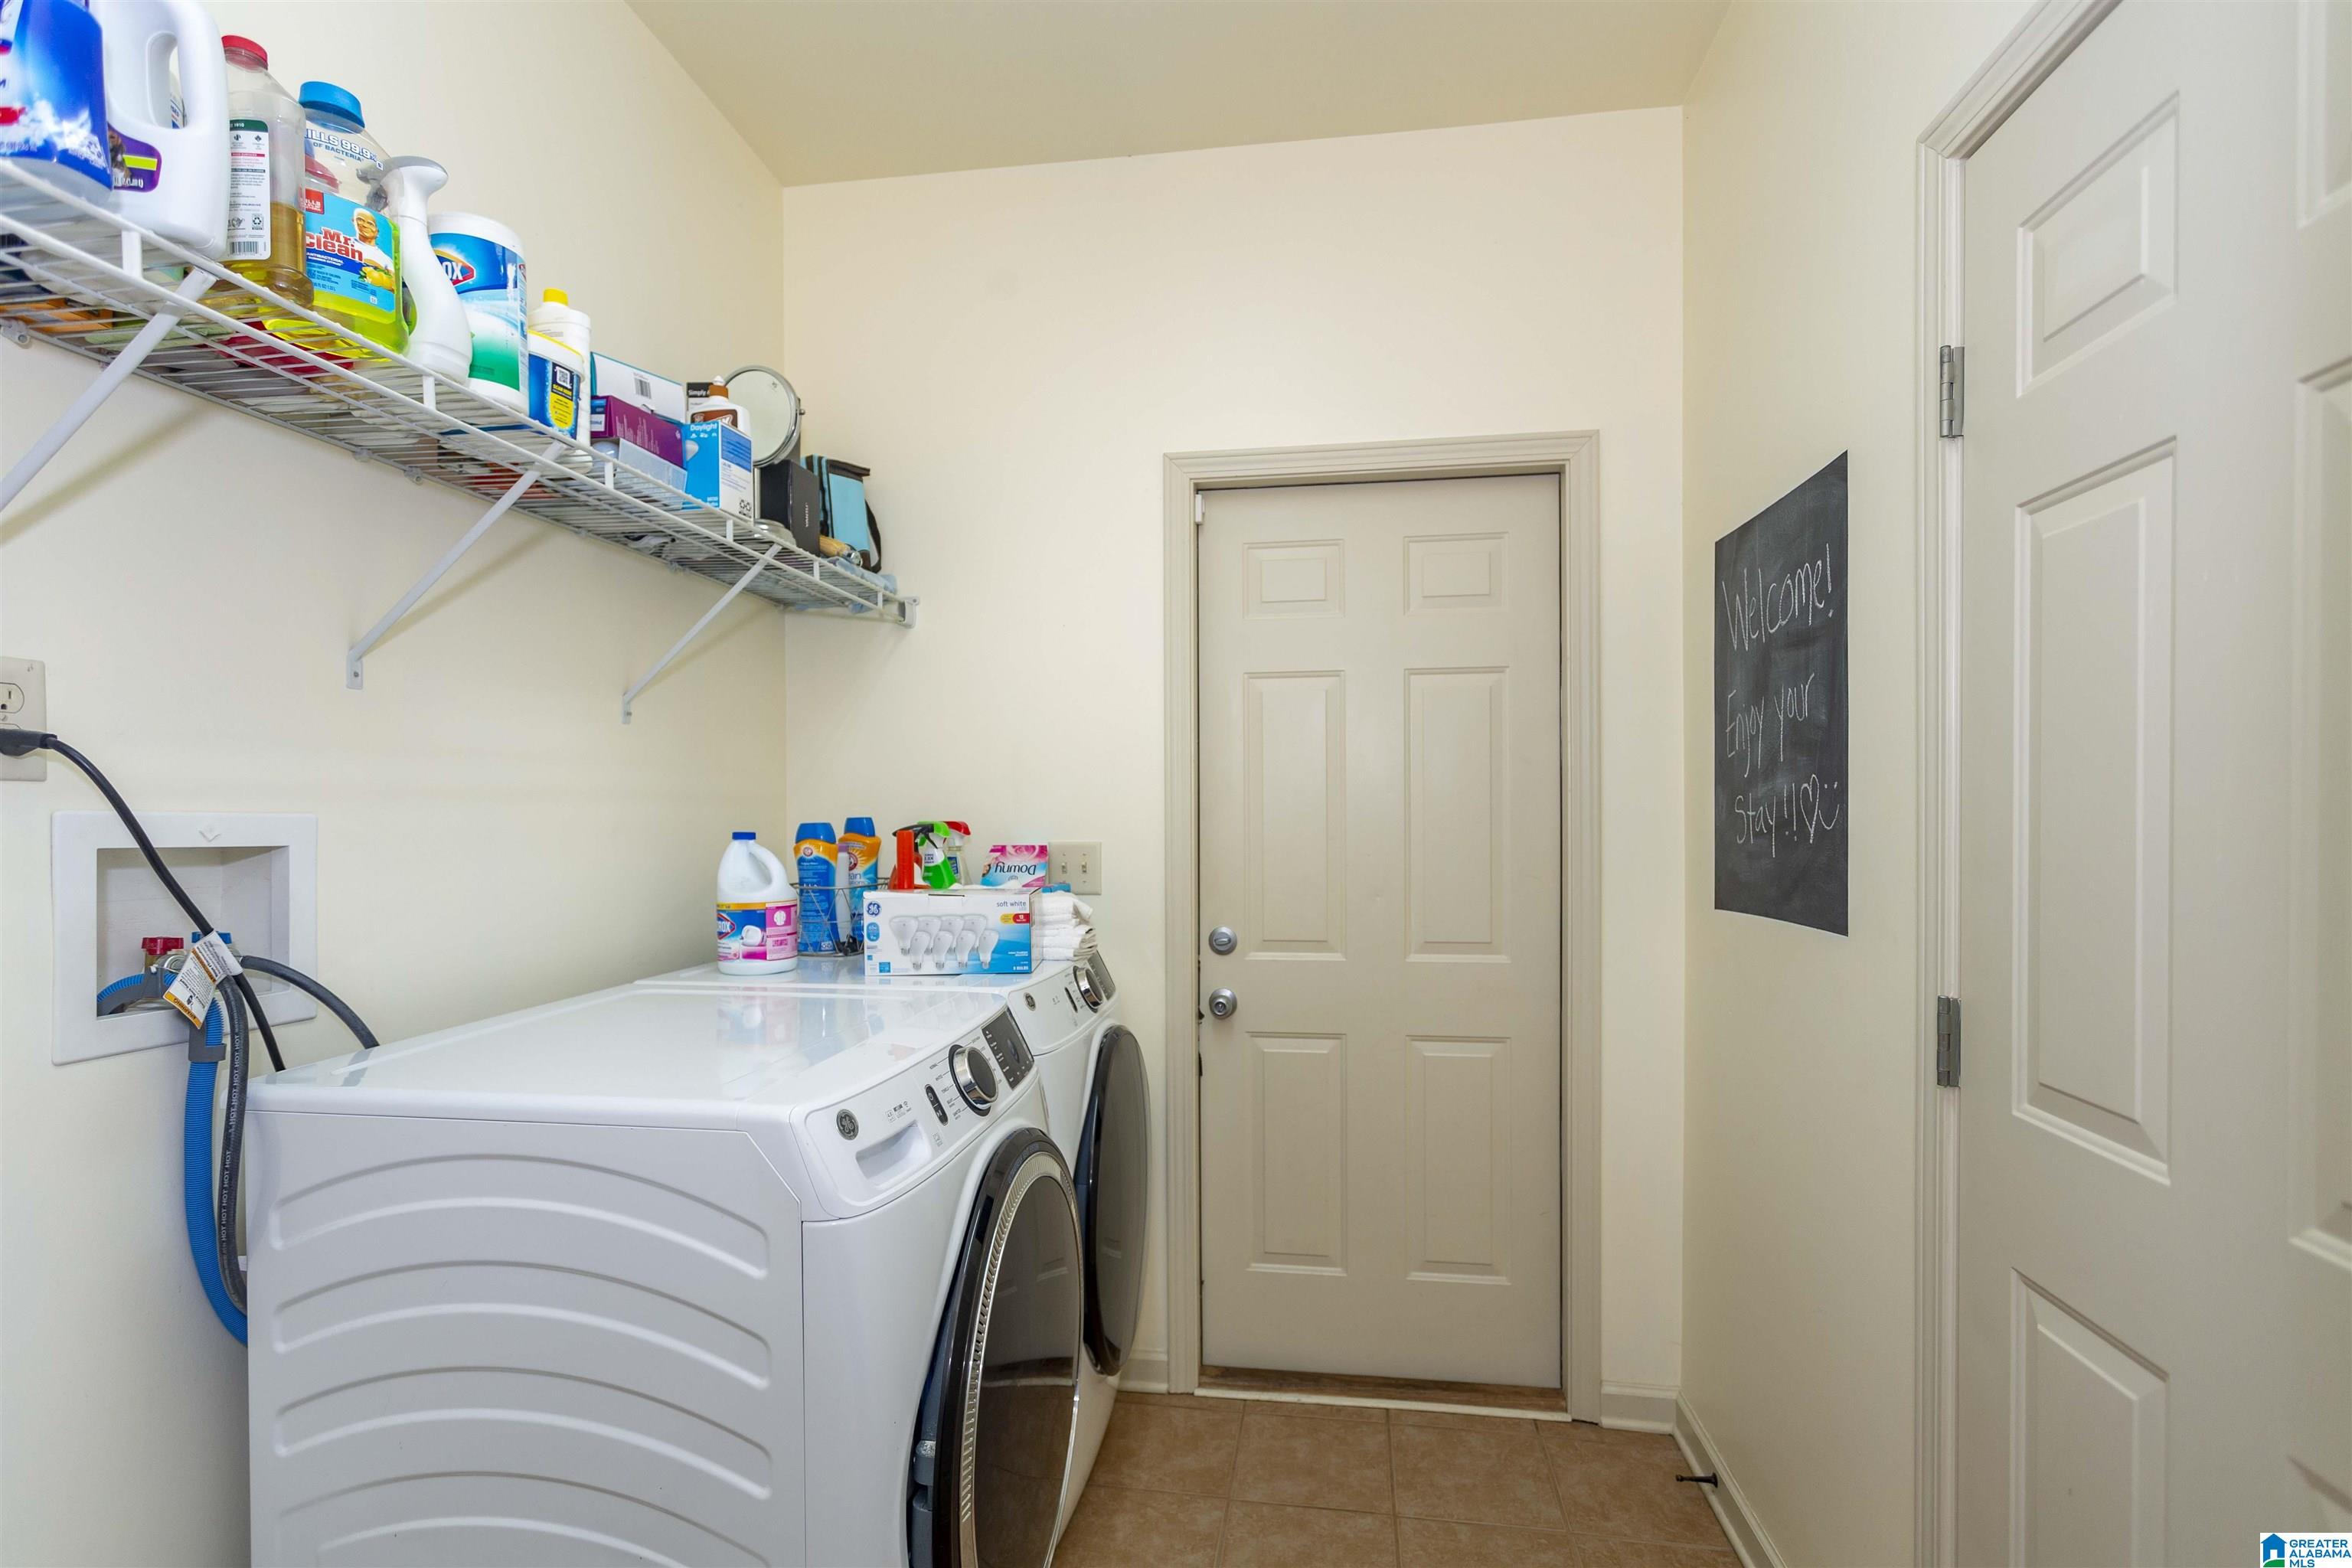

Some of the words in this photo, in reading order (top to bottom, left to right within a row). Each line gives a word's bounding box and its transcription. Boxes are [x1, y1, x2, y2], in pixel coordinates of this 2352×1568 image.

[305, 128, 338, 146] ILLS
[325, 143, 363, 162] BACTERIA
[322, 227, 355, 247] Mr.
[690, 423, 717, 432] Daylight
[1721, 542, 1834, 652] Welcome!
[1726, 689, 1765, 779] Enjoy
[1774, 672, 1815, 763] your
[995, 861, 1037, 876] Downy
